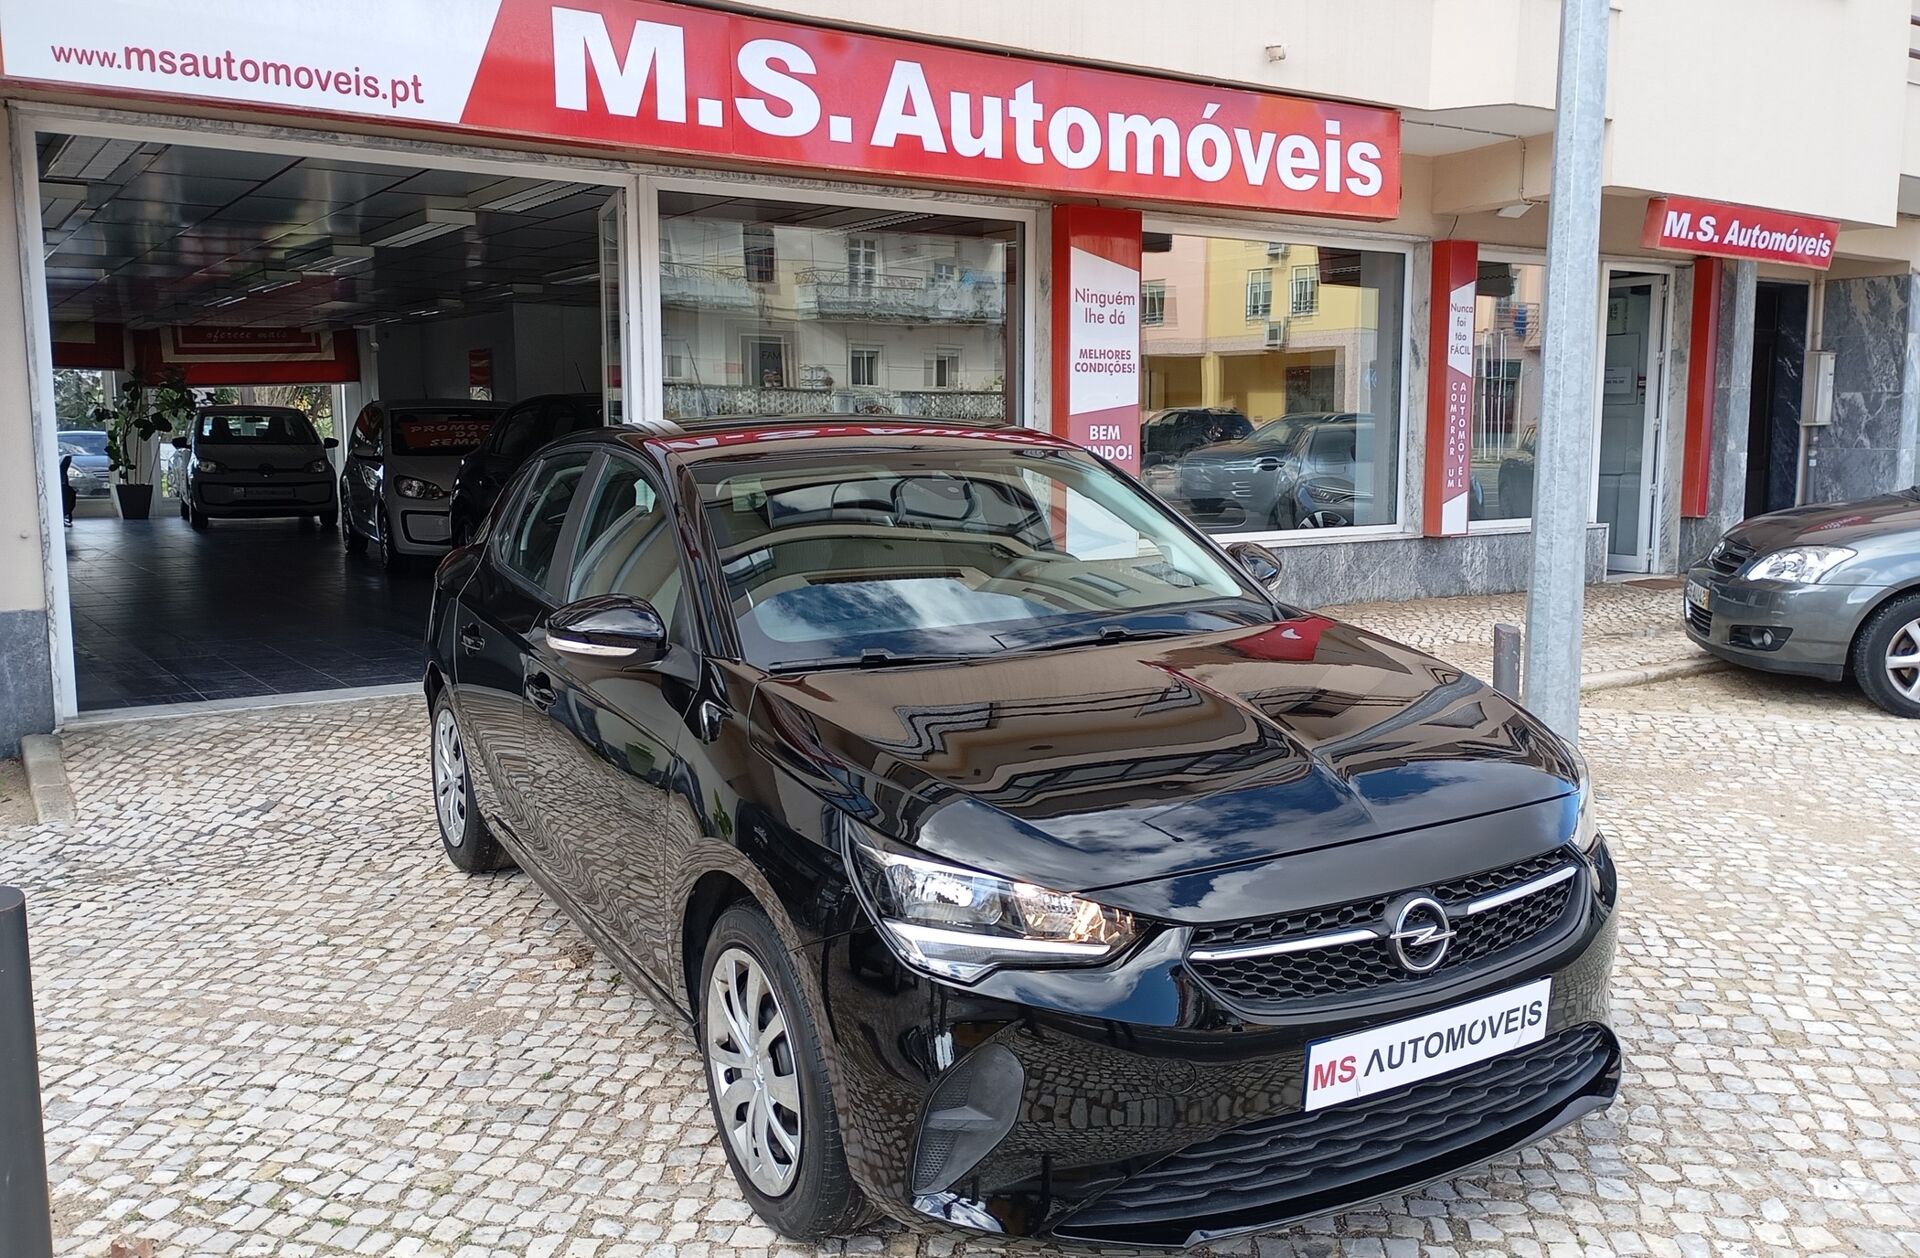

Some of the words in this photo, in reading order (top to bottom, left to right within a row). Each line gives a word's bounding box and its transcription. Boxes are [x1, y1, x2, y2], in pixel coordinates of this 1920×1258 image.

[51, 44, 424, 107] www.msautomoveis.pt
[551, 6, 853, 143] M.S.
[870, 60, 1383, 197] Automóveis
[1663, 211, 1719, 243] M.S.
[1723, 220, 1832, 258] Automóveis
[1075, 288, 1135, 308] Ninguém
[1085, 308, 1104, 324] lhe
[1109, 309, 1125, 325] dá
[1451, 304, 1473, 313] Nunca
[1457, 317, 1467, 327] foi
[1079, 349, 1131, 360] MELHORES
[1450, 345, 1471, 355] FÁCIL
[1075, 361, 1135, 376] CONDIÇÕES!
[1449, 382, 1458, 456] COMPRAR
[1089, 425, 1121, 440] BEM
[1458, 382, 1467, 488] AUTOMÓVEL
[1084, 445, 1132, 460] NDO!
[1447, 468, 1455, 488] UM
[1312, 1055, 1357, 1091] MS
